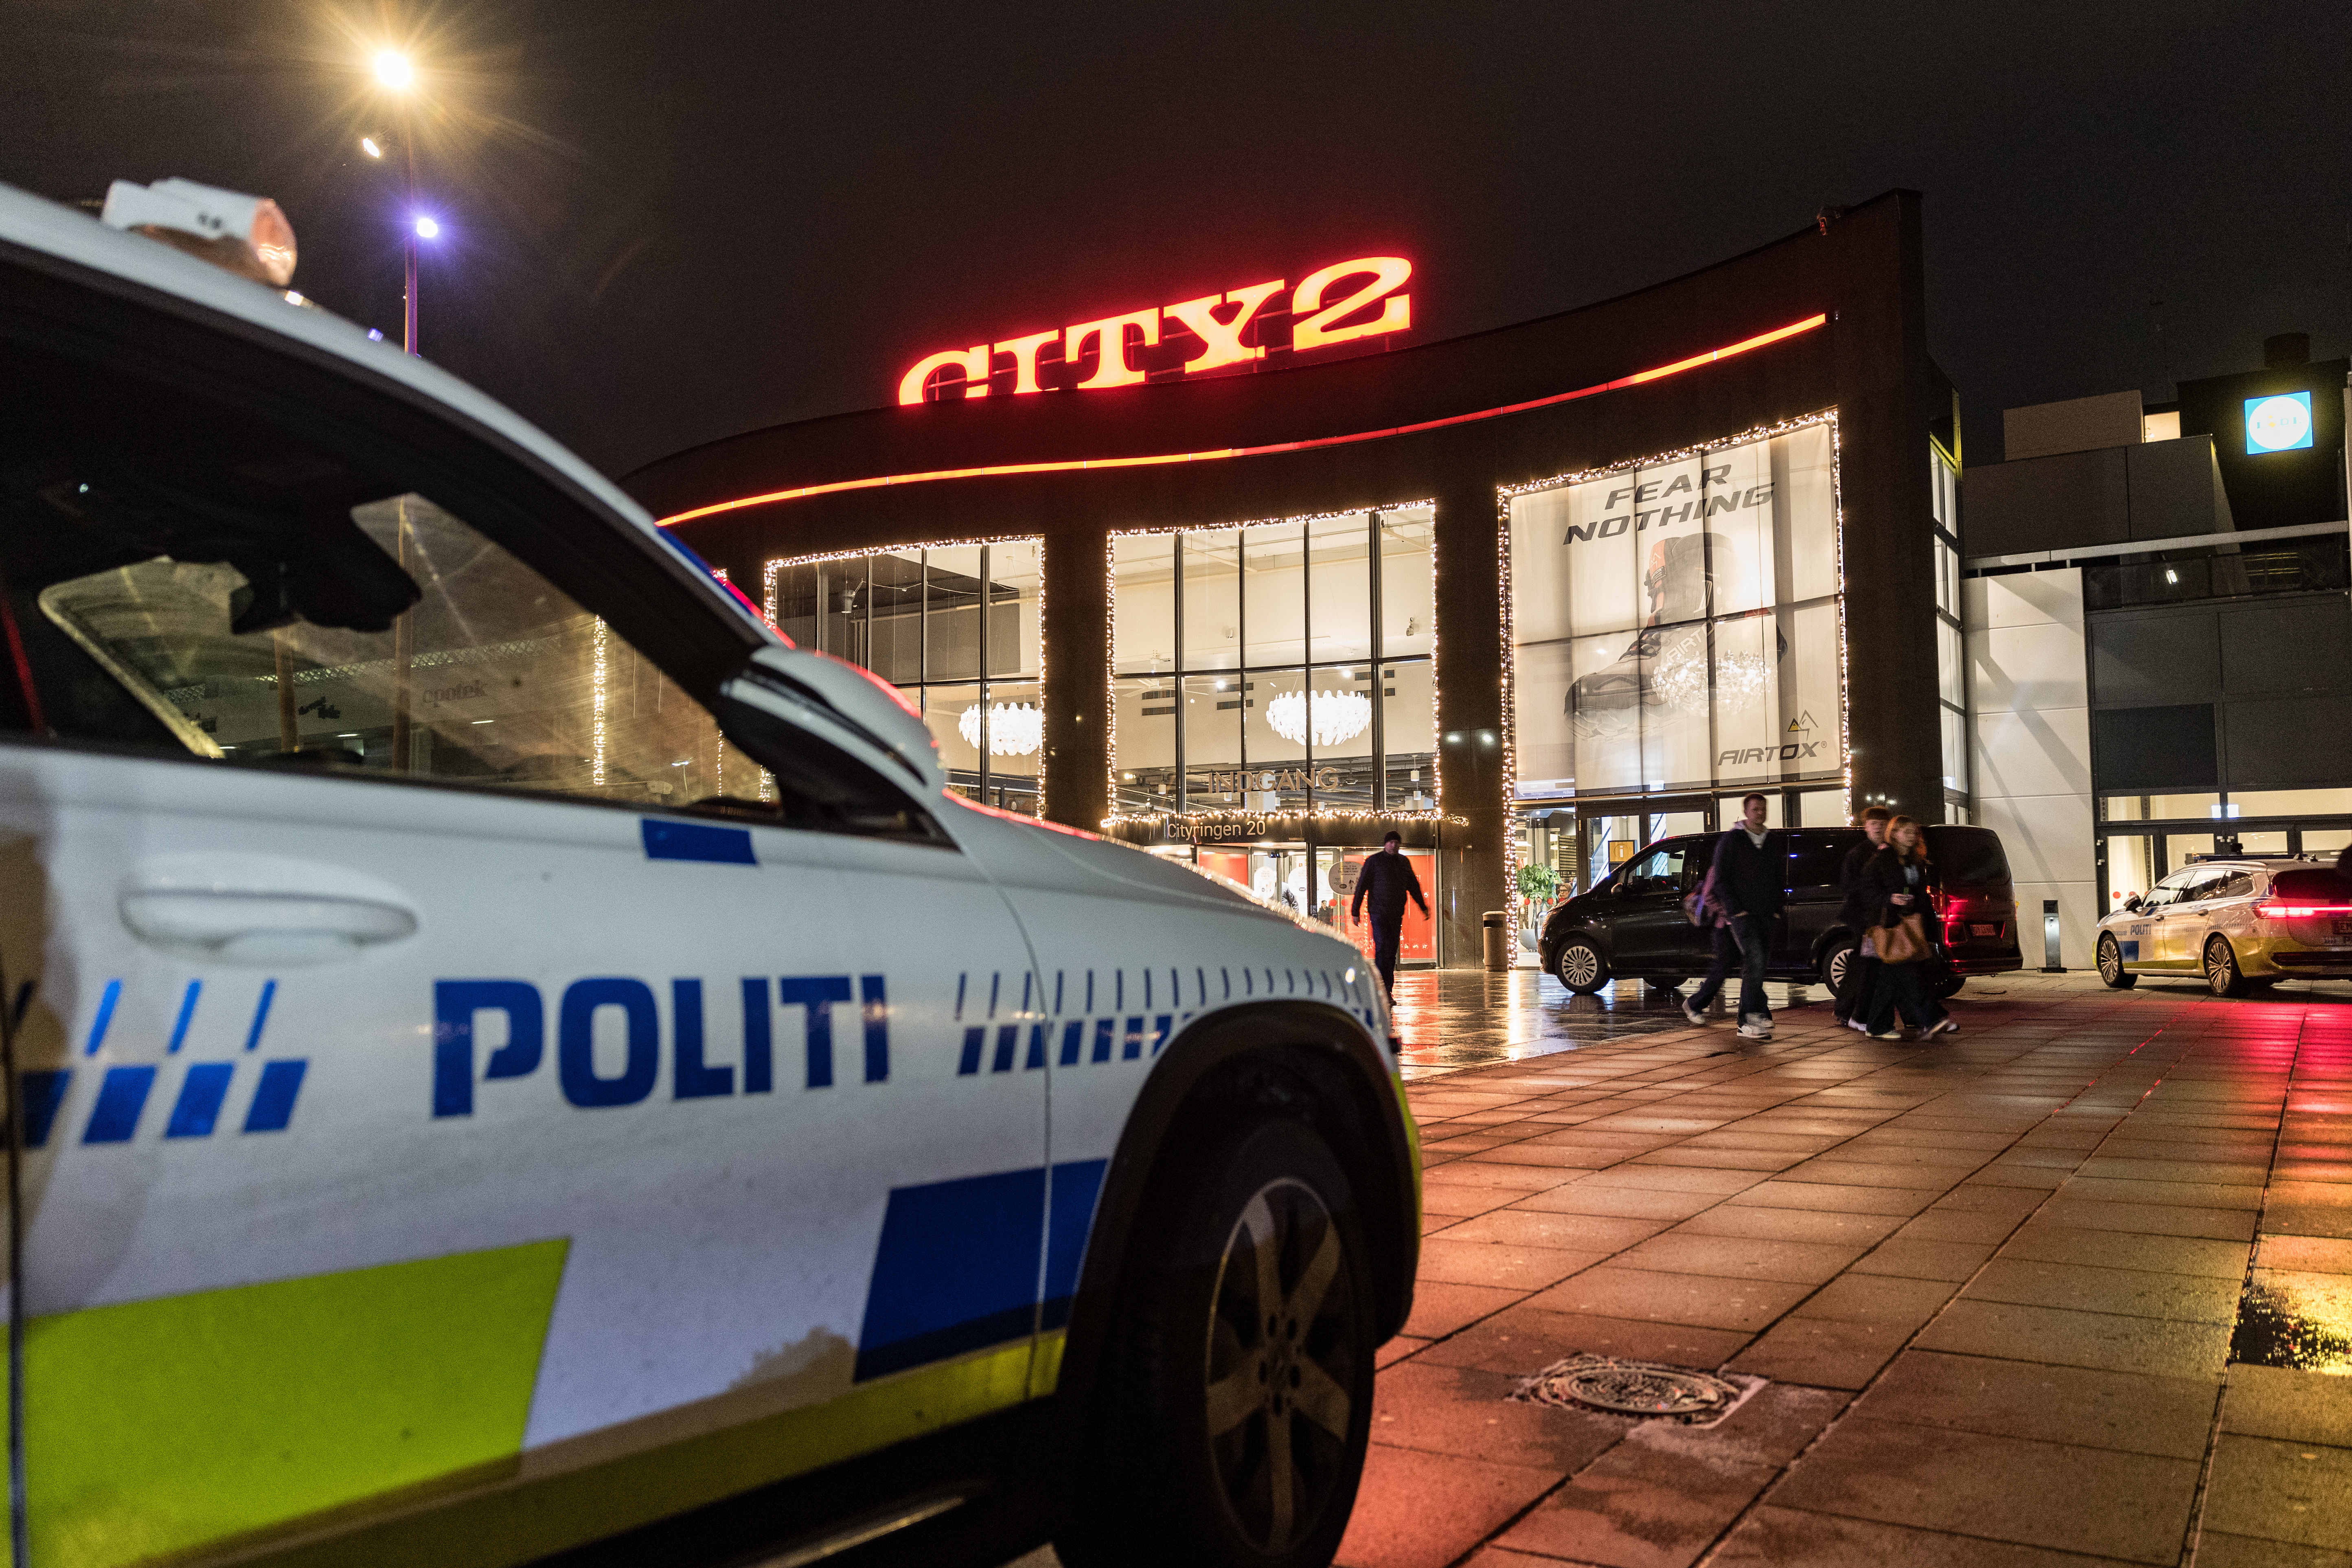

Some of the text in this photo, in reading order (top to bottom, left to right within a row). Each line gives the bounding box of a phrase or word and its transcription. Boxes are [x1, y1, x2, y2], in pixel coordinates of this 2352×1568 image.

[1604, 464, 1732, 510] FEAR
[1563, 482, 1776, 545] NOTHING
[1208, 767, 1339, 794] INDGANG
[1167, 820, 1266, 842] Cityringen 20
[2130, 923, 2152, 936] POLITI
[431, 973, 892, 1120] POLITI
